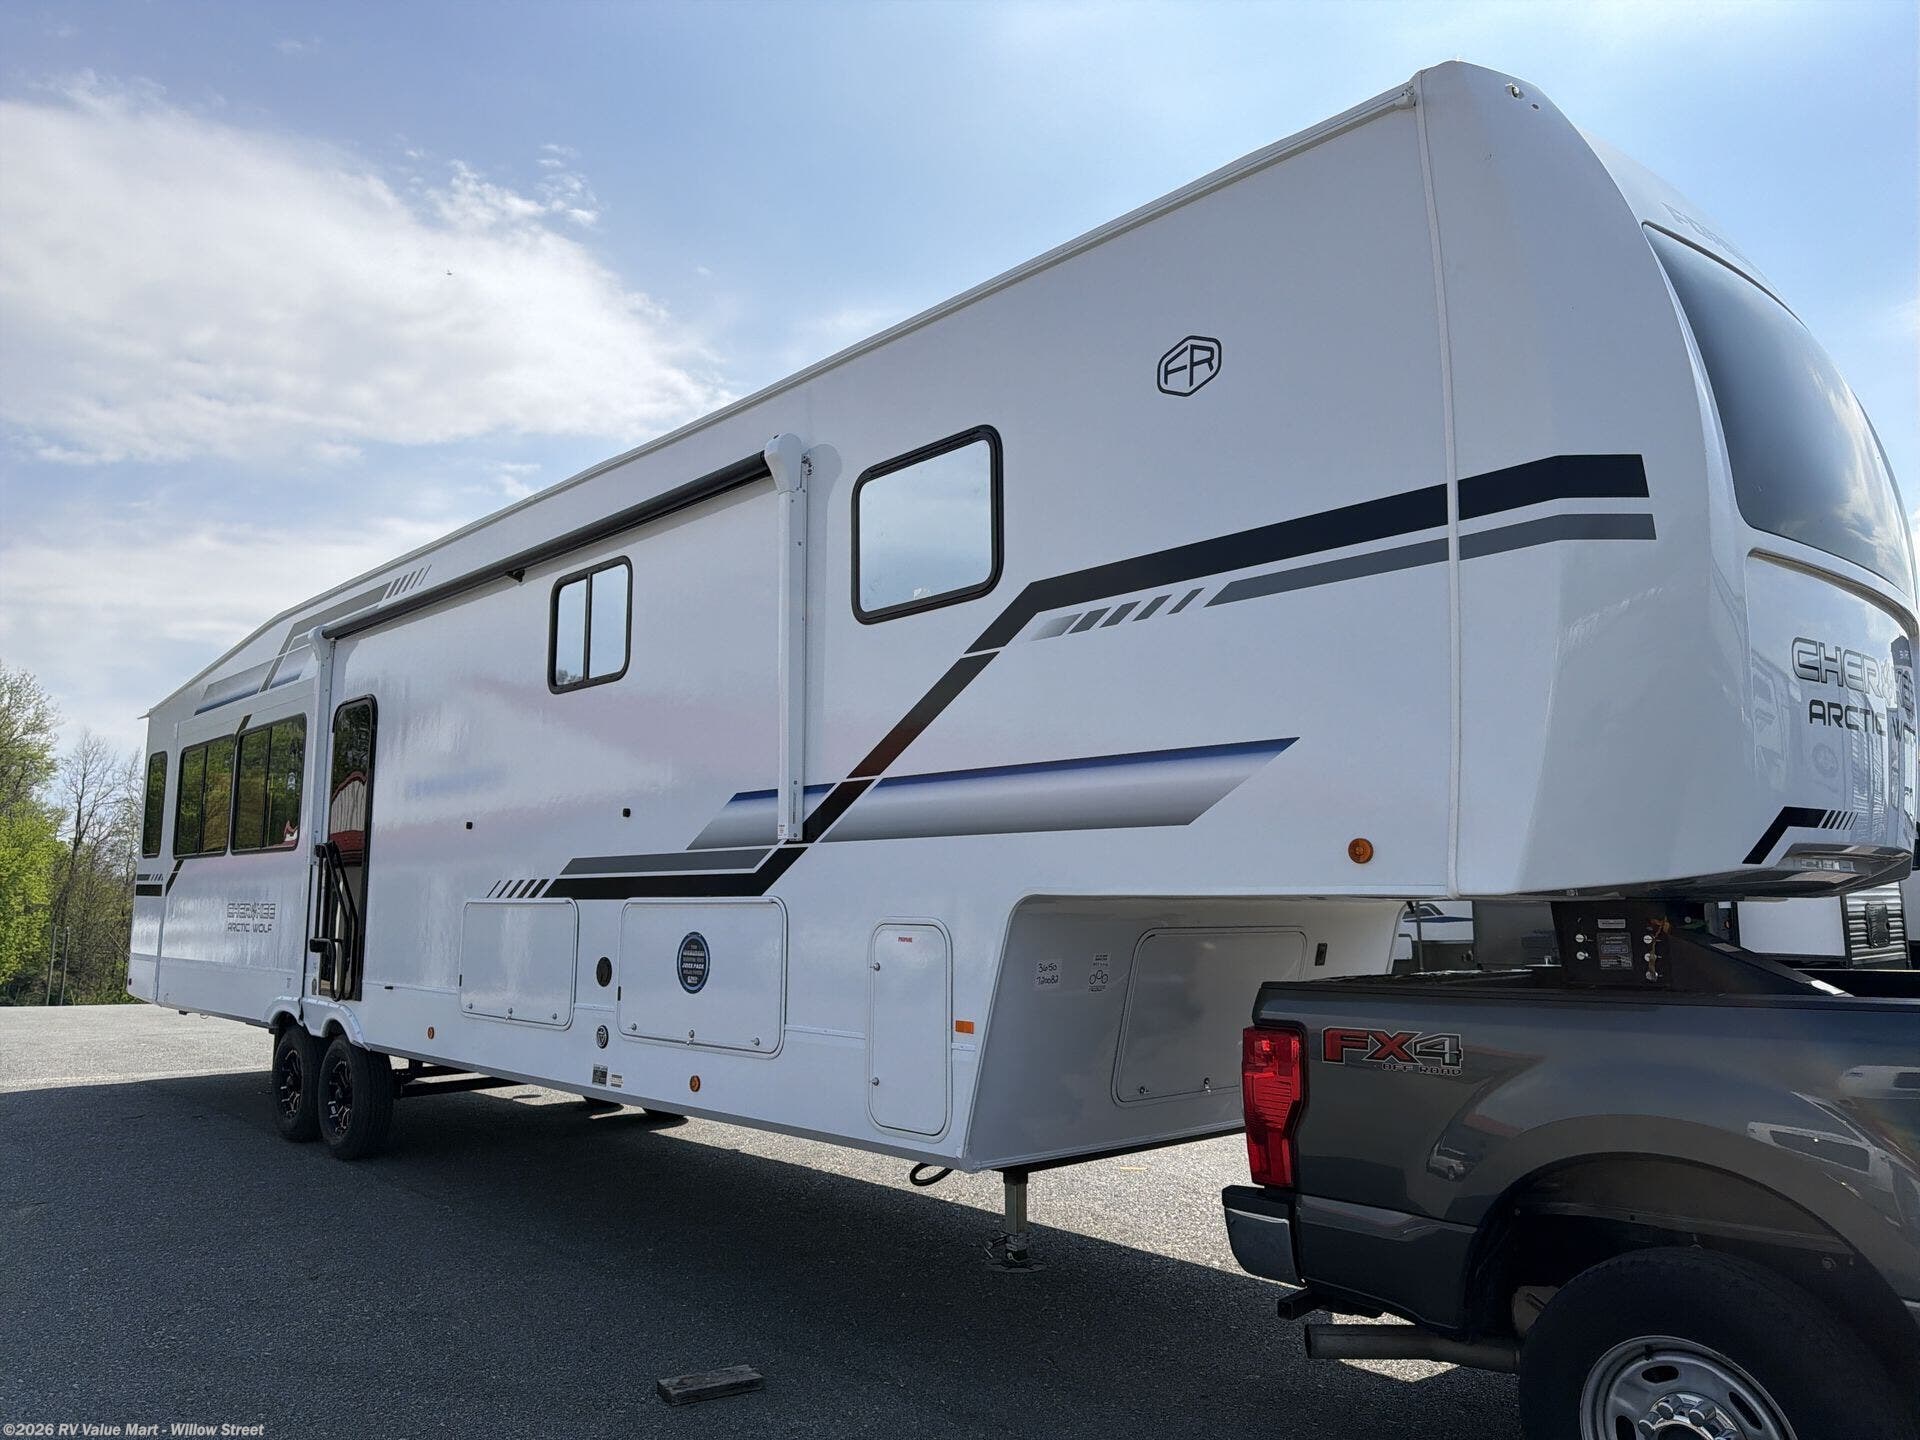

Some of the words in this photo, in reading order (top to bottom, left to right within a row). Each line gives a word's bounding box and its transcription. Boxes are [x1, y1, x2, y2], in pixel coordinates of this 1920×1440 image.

[1809, 699, 1886, 737] ARCTIC
[228, 923, 250, 932] ARCTIC
[253, 923, 272, 933] WOLF
[1322, 1026, 1463, 1068] FX4
[1382, 1063, 1414, 1073] OFF
[1419, 1066, 1462, 1077] ROAD
